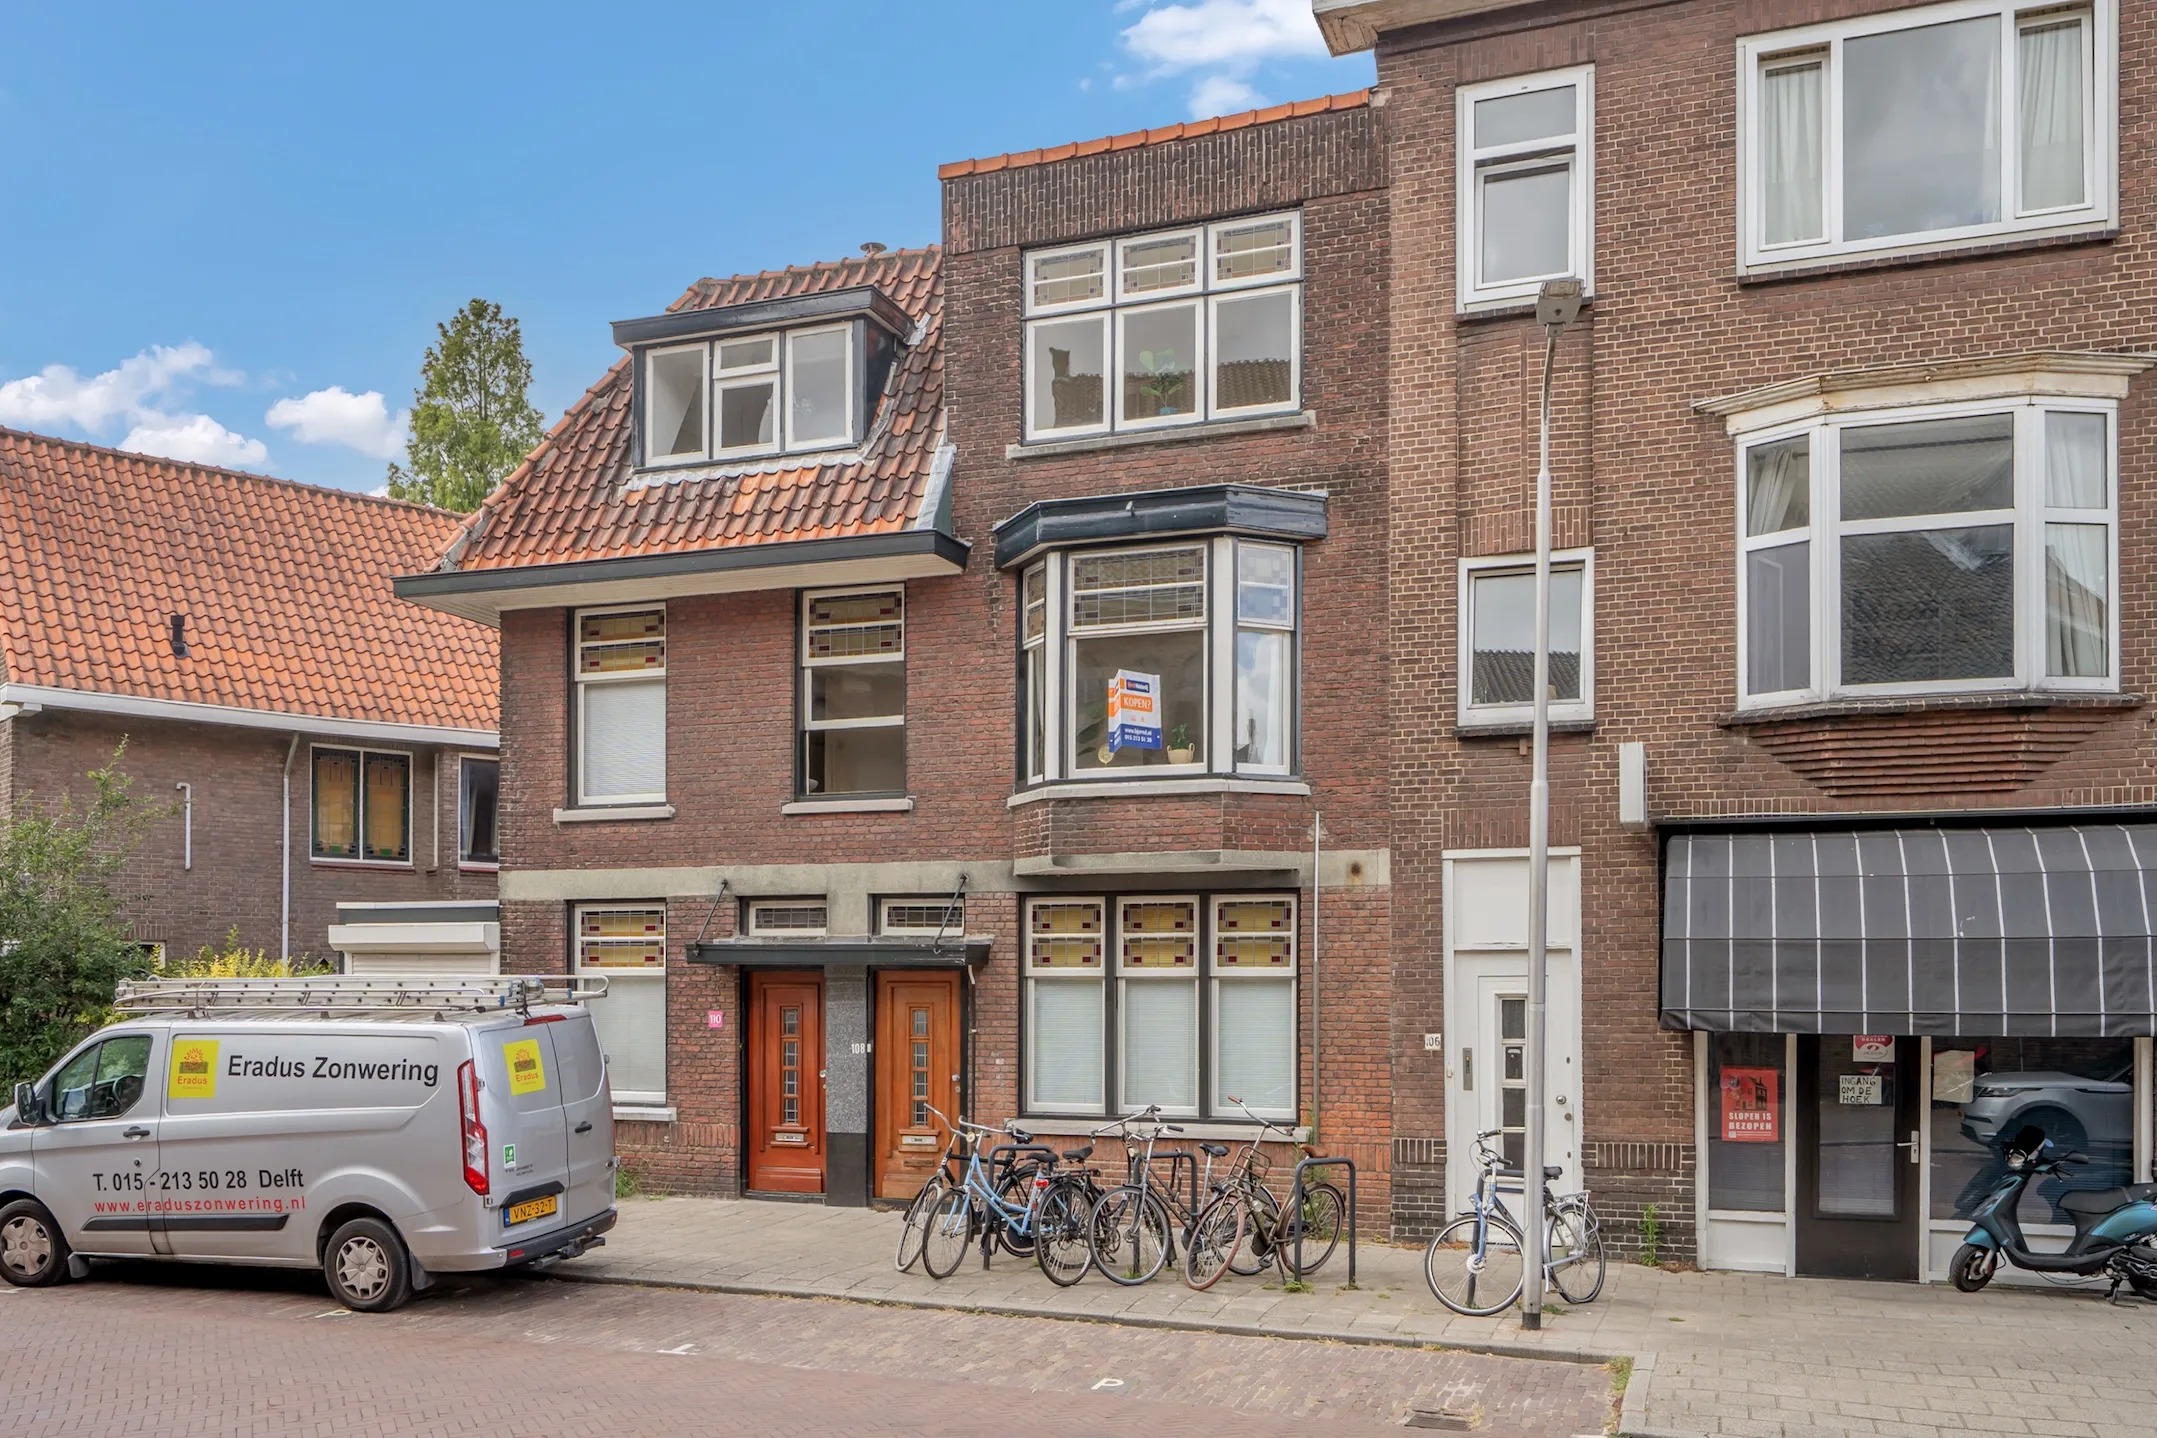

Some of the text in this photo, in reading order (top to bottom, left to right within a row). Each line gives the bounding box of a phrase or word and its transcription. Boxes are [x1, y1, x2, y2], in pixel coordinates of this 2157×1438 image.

[1123, 696, 1152, 709] KOPEN?
[709, 1014, 722, 1024] 110
[851, 1043, 865, 1054] 108
[228, 1055, 439, 1087] Eradus Zonwering
[177, 1076, 208, 1085] Eradus
[515, 1072, 539, 1082] Eradus
[1841, 1077, 1876, 1086] INGANG
[1841, 1086, 1872, 1095] OM DE
[1842, 1095, 1870, 1104] HOEK
[1729, 1112, 1760, 1120] SLOPEN
[1729, 1122, 1772, 1130] BEZOPEN
[93, 1173, 107, 1191] T.
[113, 1173, 143, 1191] 015
[160, 1172, 192, 1190] 213
[199, 1171, 219, 1189] 50
[225, 1170, 247, 1189] 28
[259, 1169, 304, 1188] Delft
[94, 1196, 305, 1212] www.eraduszonwering.nl
[513, 1199, 553, 1219] VNZ-32-T
